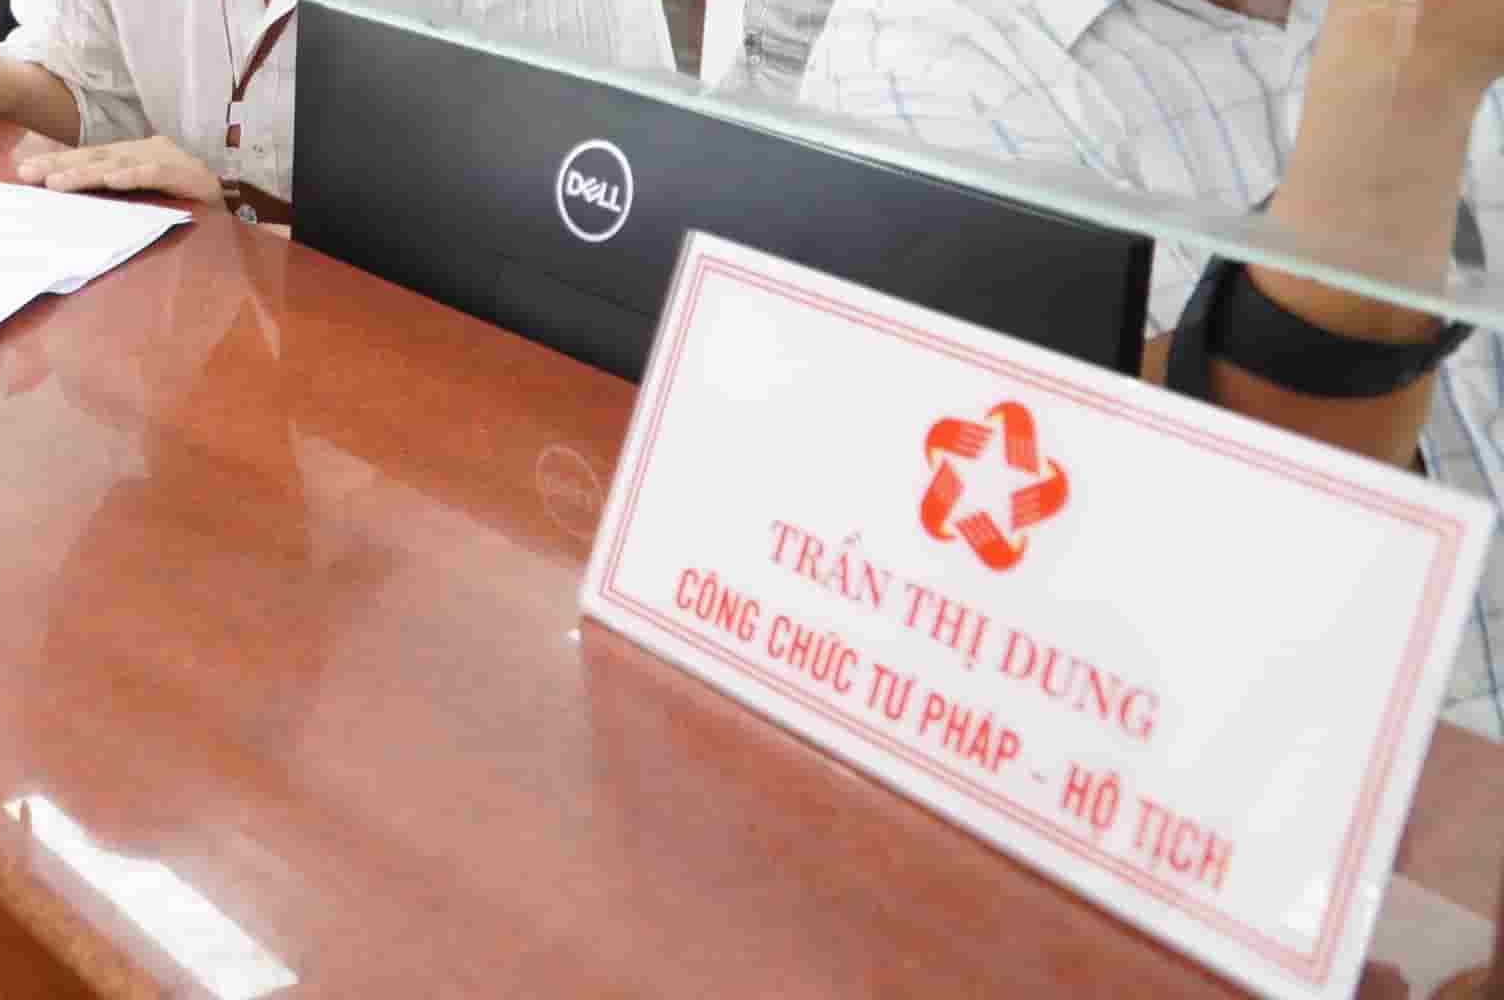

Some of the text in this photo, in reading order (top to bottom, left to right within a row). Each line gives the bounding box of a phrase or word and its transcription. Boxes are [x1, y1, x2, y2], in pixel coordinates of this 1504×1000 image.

[565, 169, 623, 213] DELL
[675, 567, 761, 642] CÔNG
[918, 692, 1023, 774] PHÁP
[905, 583, 991, 670] THỊ
[999, 629, 1162, 742] DUNG
